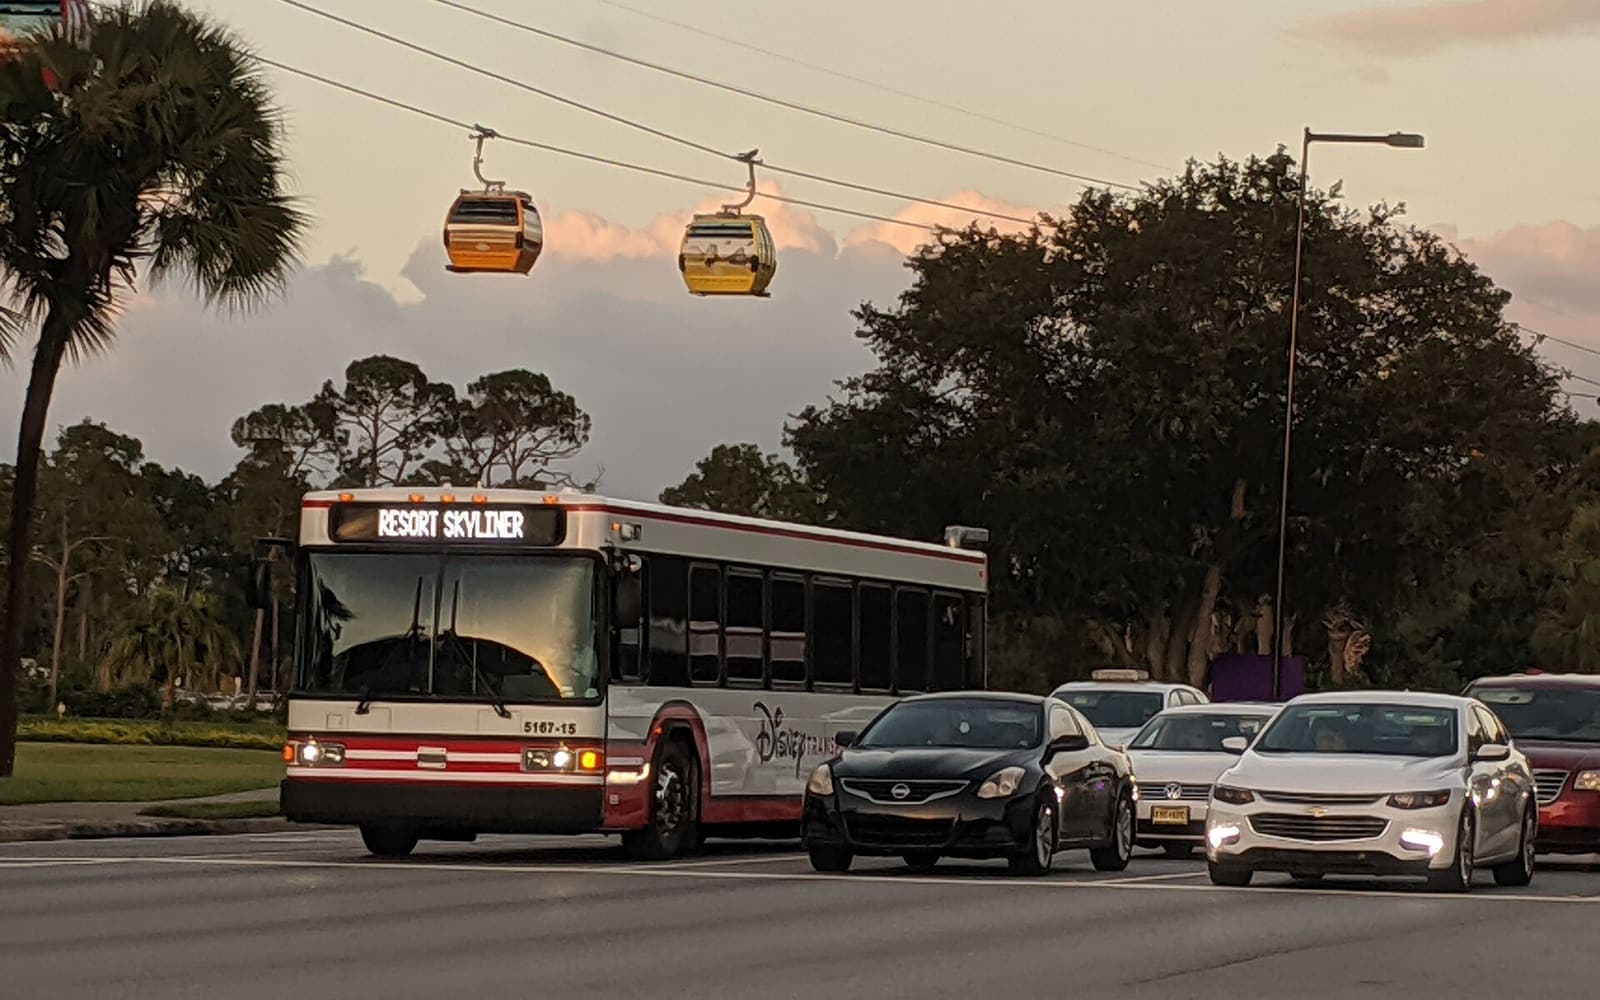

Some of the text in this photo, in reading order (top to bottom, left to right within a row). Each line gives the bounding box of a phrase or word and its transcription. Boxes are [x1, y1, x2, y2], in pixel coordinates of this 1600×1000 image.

[378, 508, 524, 538] RESORT SKYLINER
[523, 721, 577, 735] 5167-15
